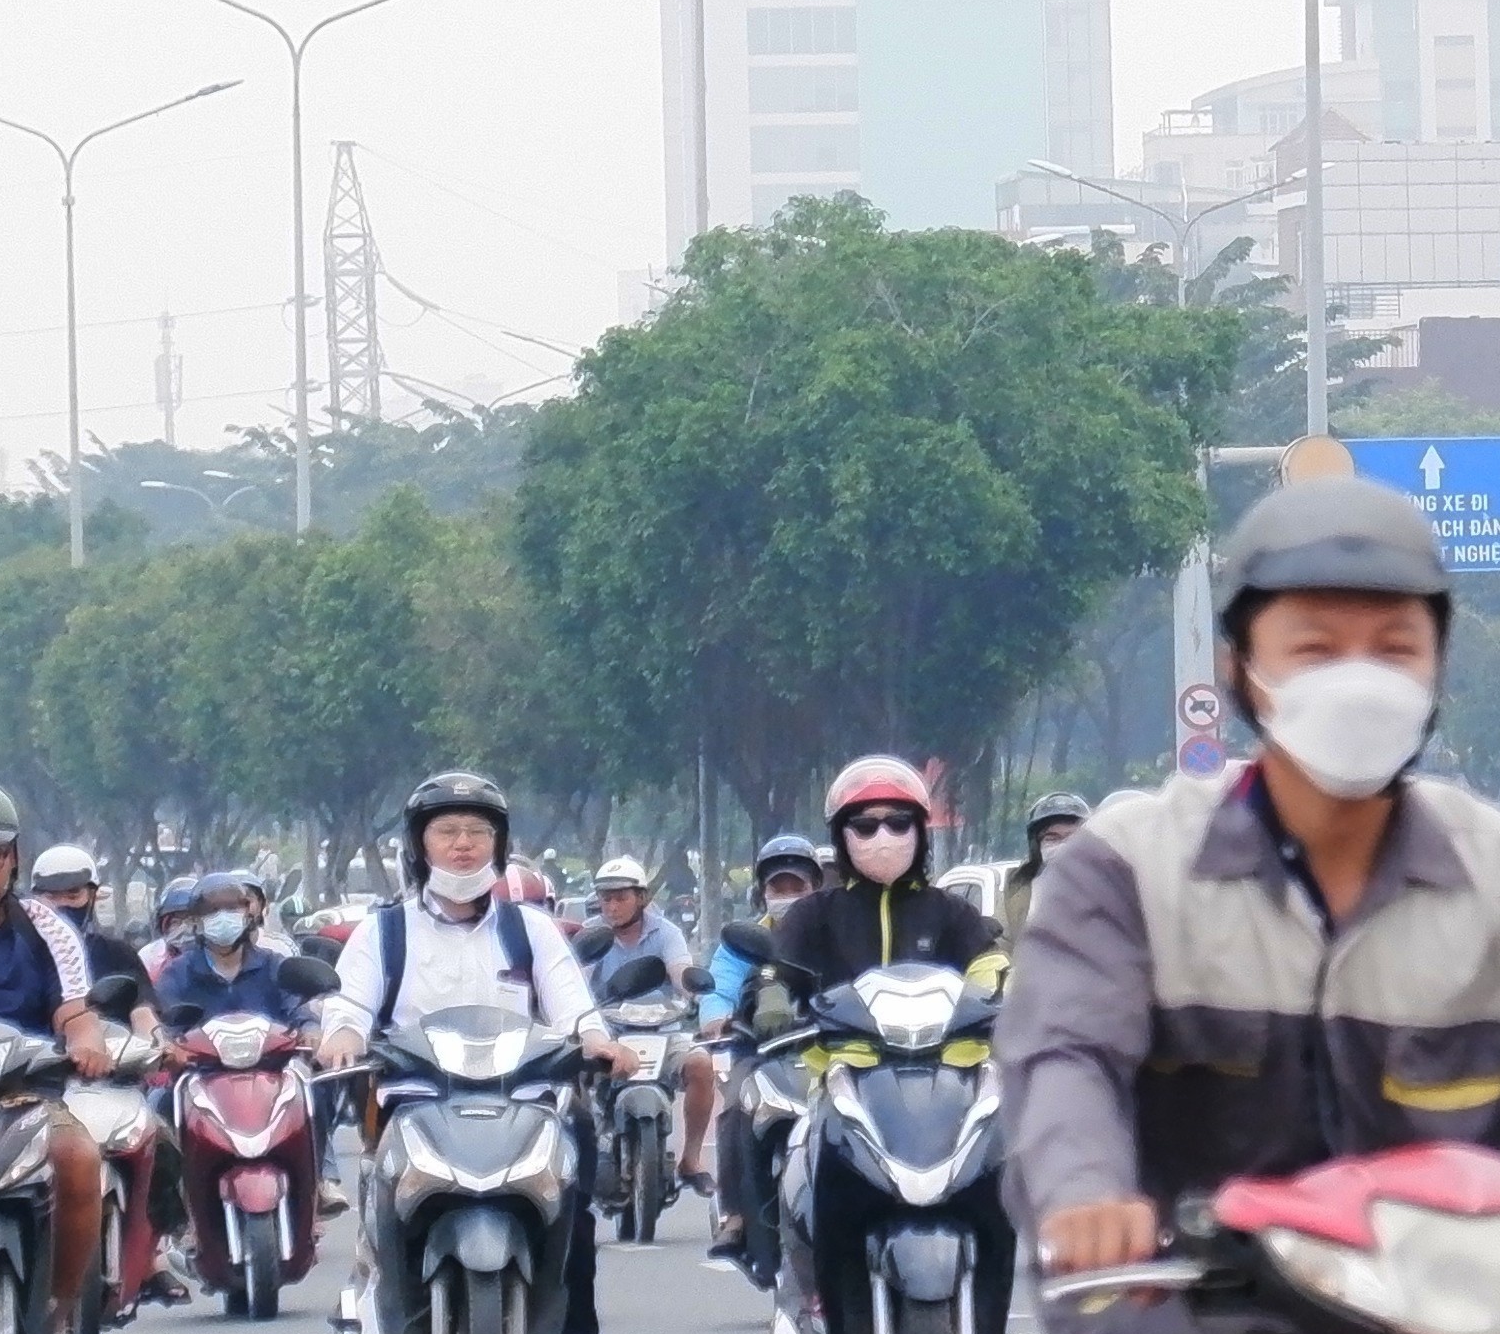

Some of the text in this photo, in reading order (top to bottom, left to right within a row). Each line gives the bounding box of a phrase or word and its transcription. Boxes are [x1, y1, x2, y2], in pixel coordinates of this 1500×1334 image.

[1443, 494, 1465, 512] XE
[1470, 493, 1488, 511] ĐI
[1454, 541, 1500, 565] NGHỆ
